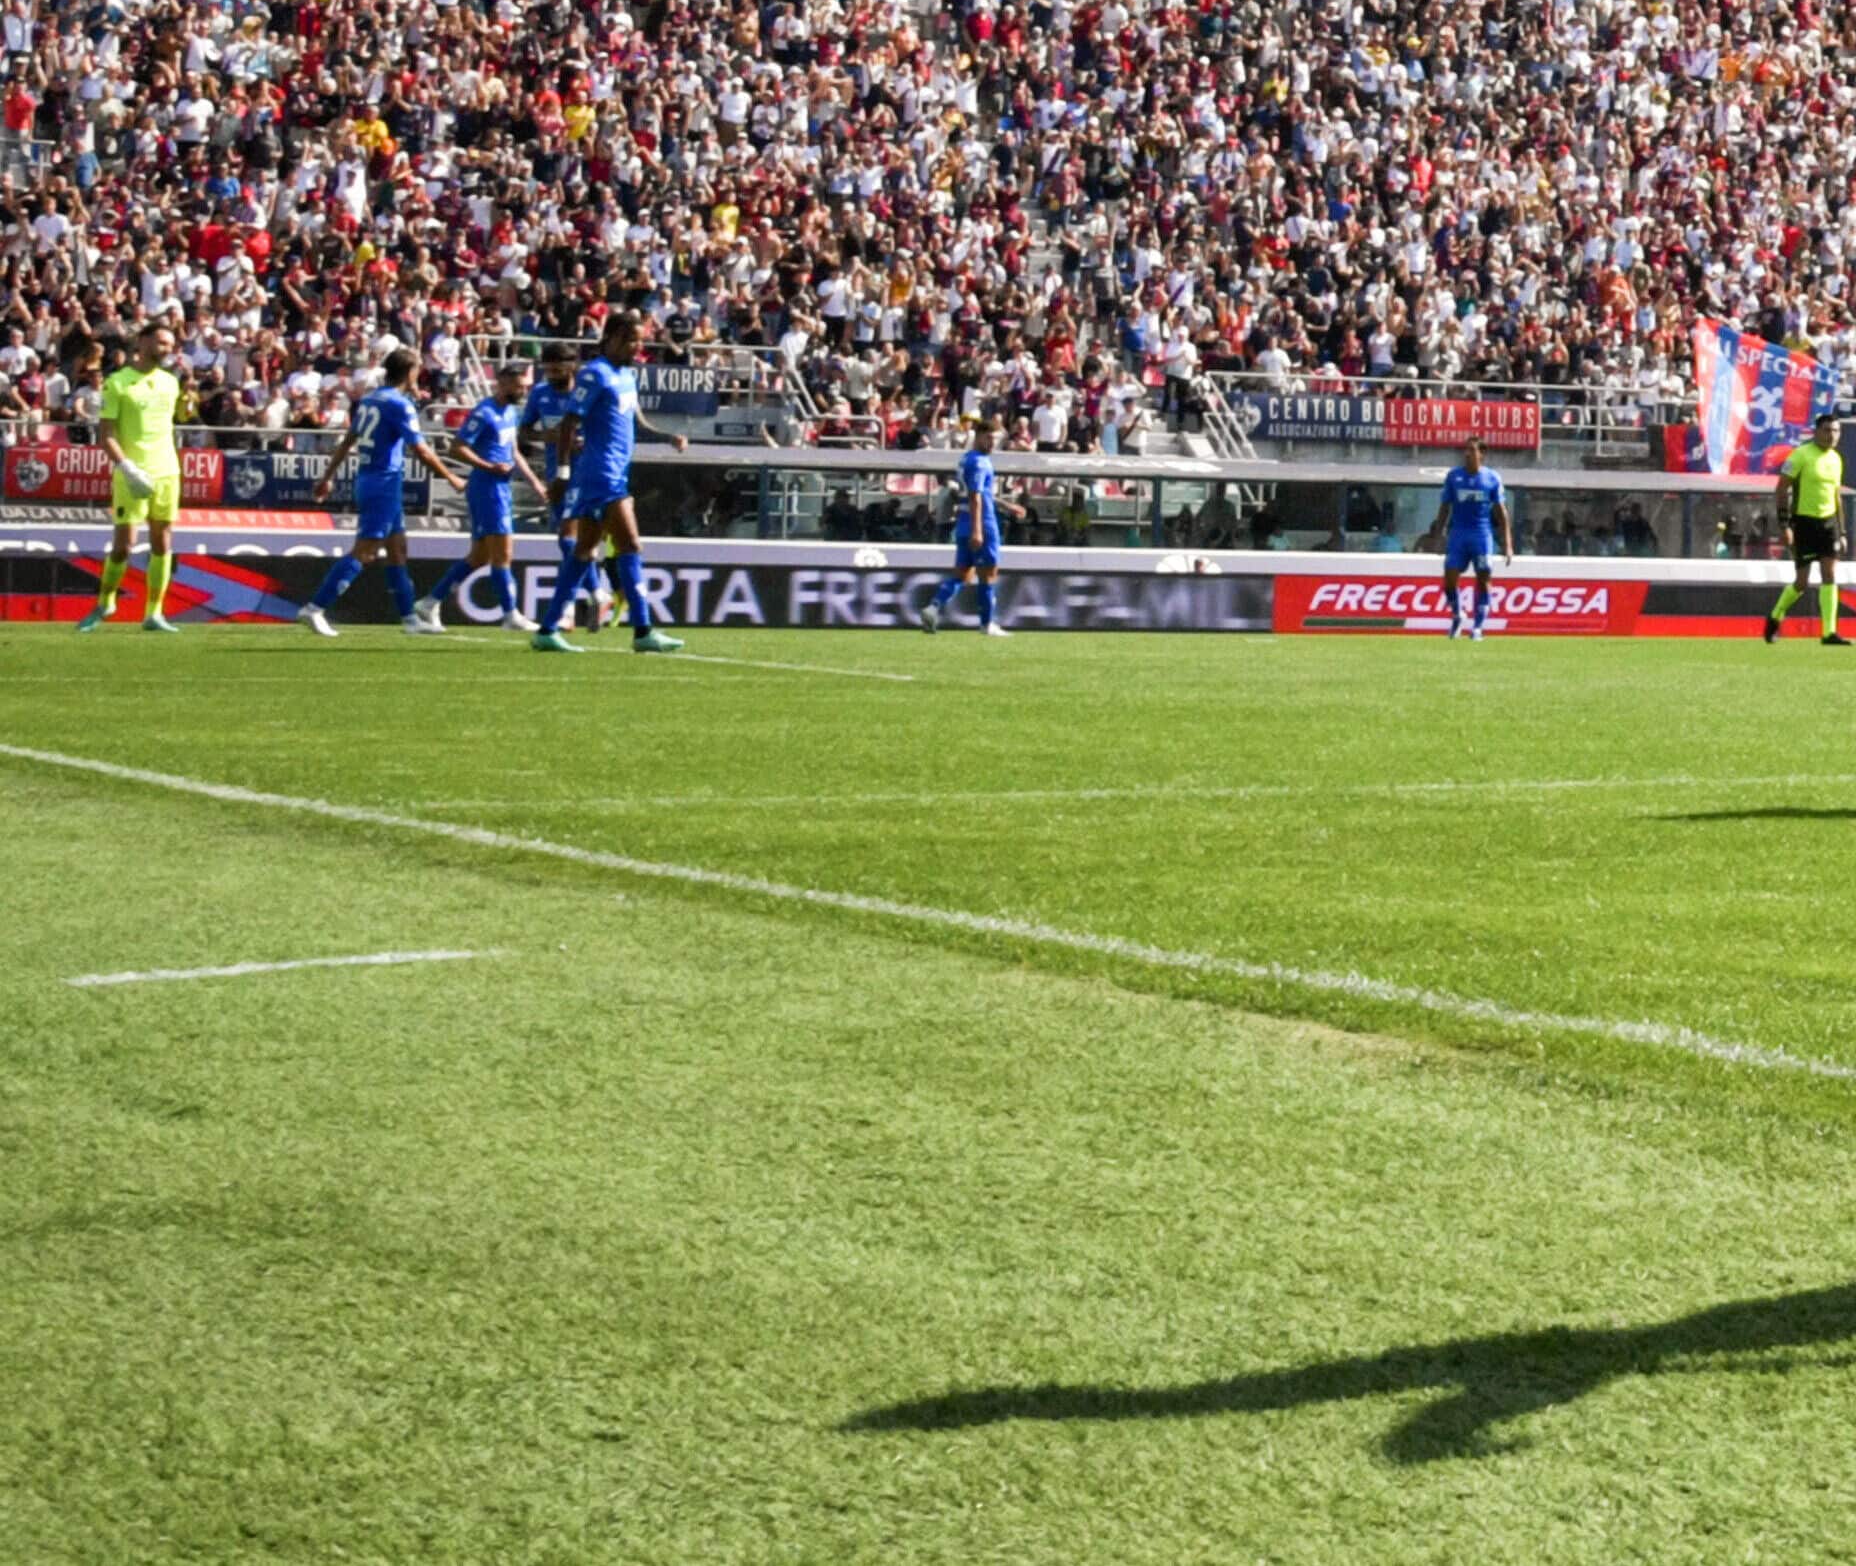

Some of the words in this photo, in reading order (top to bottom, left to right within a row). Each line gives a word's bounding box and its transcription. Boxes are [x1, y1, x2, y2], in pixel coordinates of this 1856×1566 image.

[656, 368, 716, 393] KORPS
[1268, 397, 1351, 422] CENTRO
[1361, 399, 1456, 427] BOLOGNA
[1471, 404, 1537, 430] CLUBS
[183, 452, 220, 478] CEV
